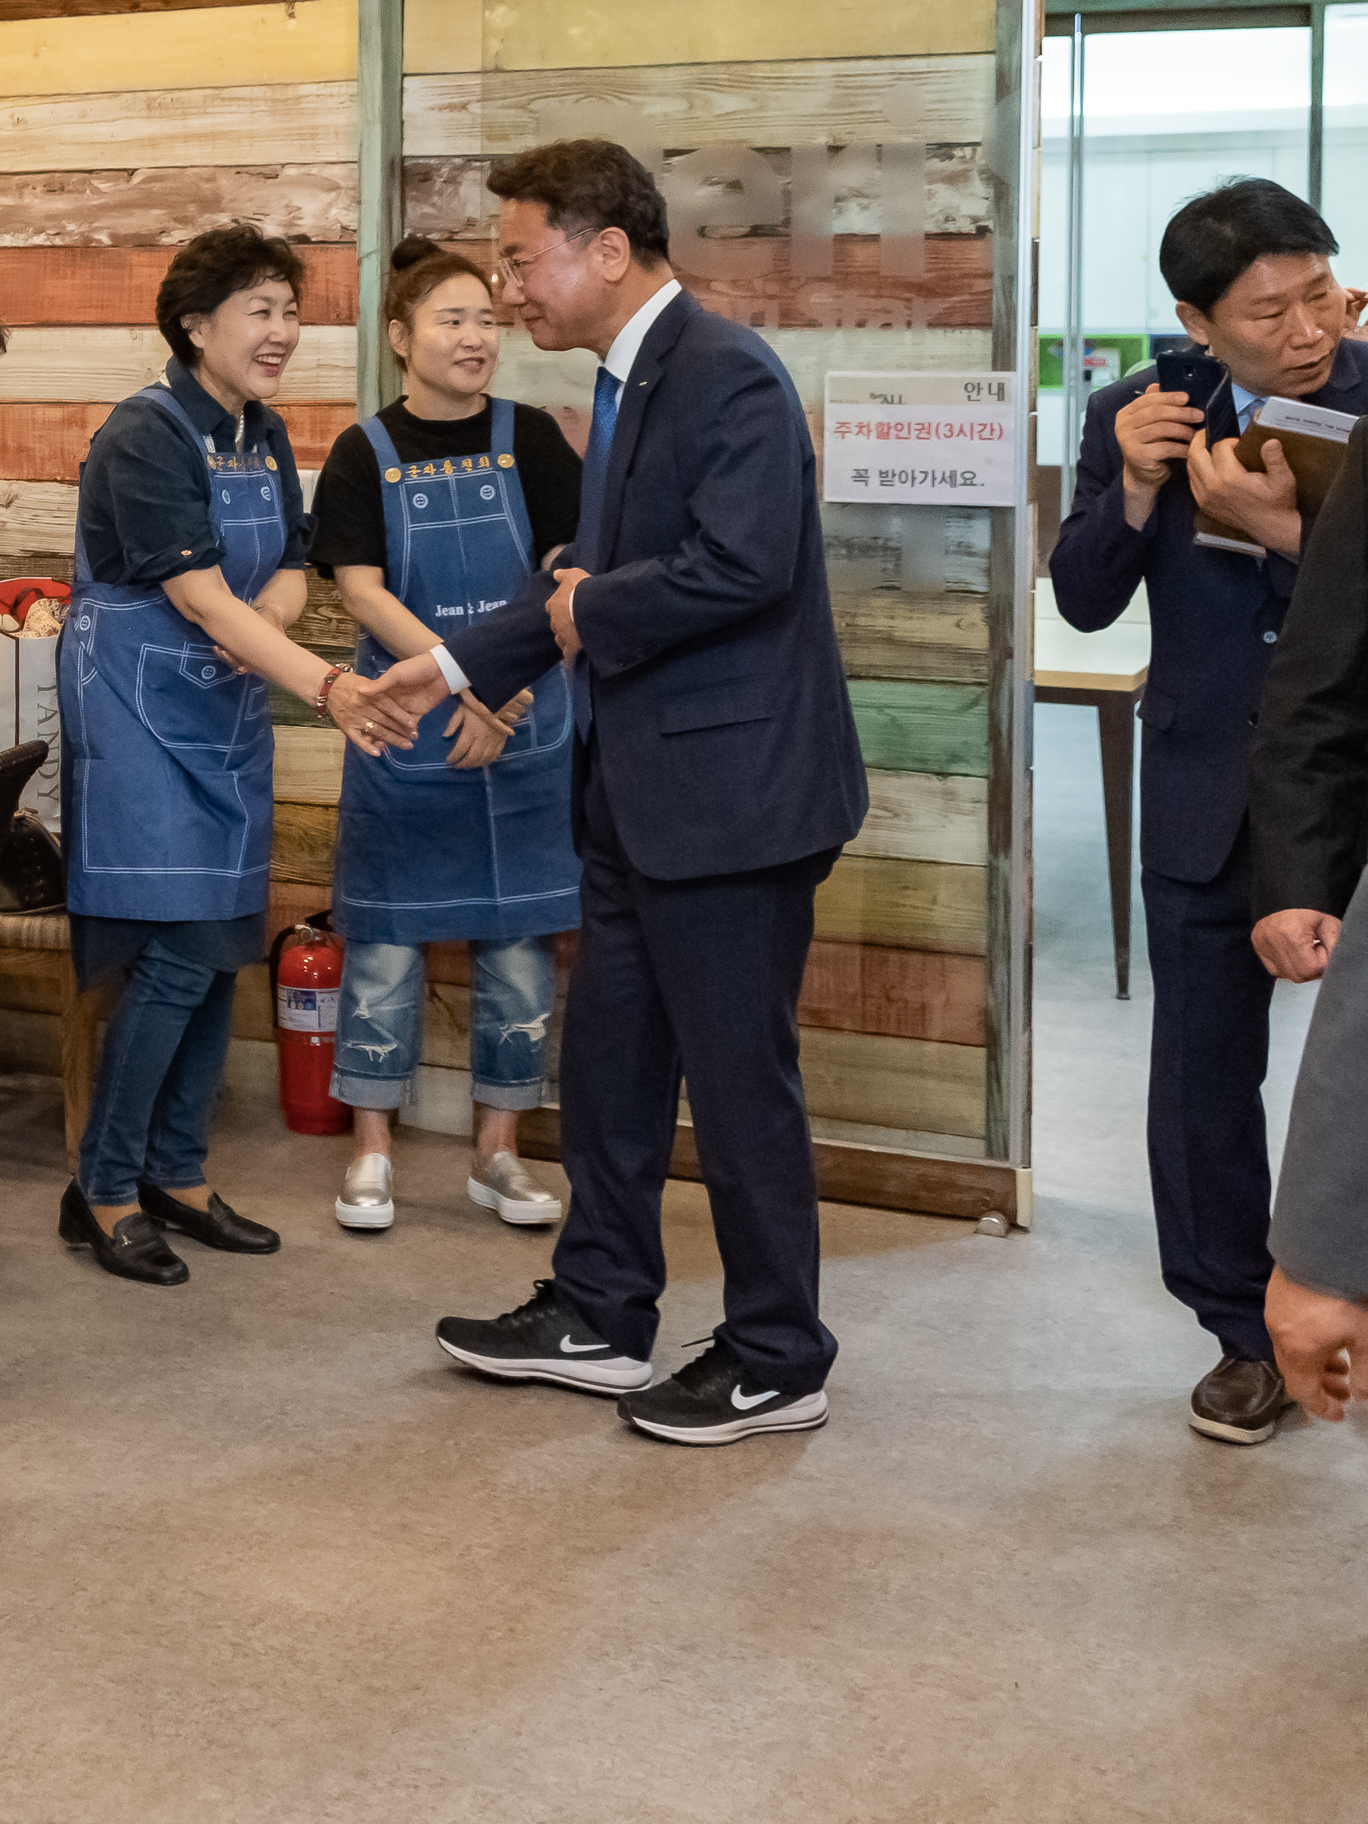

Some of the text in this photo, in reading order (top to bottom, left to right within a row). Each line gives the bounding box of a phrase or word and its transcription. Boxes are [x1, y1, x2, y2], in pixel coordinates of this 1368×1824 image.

[964, 382, 1006, 402] 안내
[833, 421, 1004, 441] 주차할인권(3시간)
[850, 468, 985, 488] 꼭 받아가세요.
[435, 604, 464, 617] Jean
